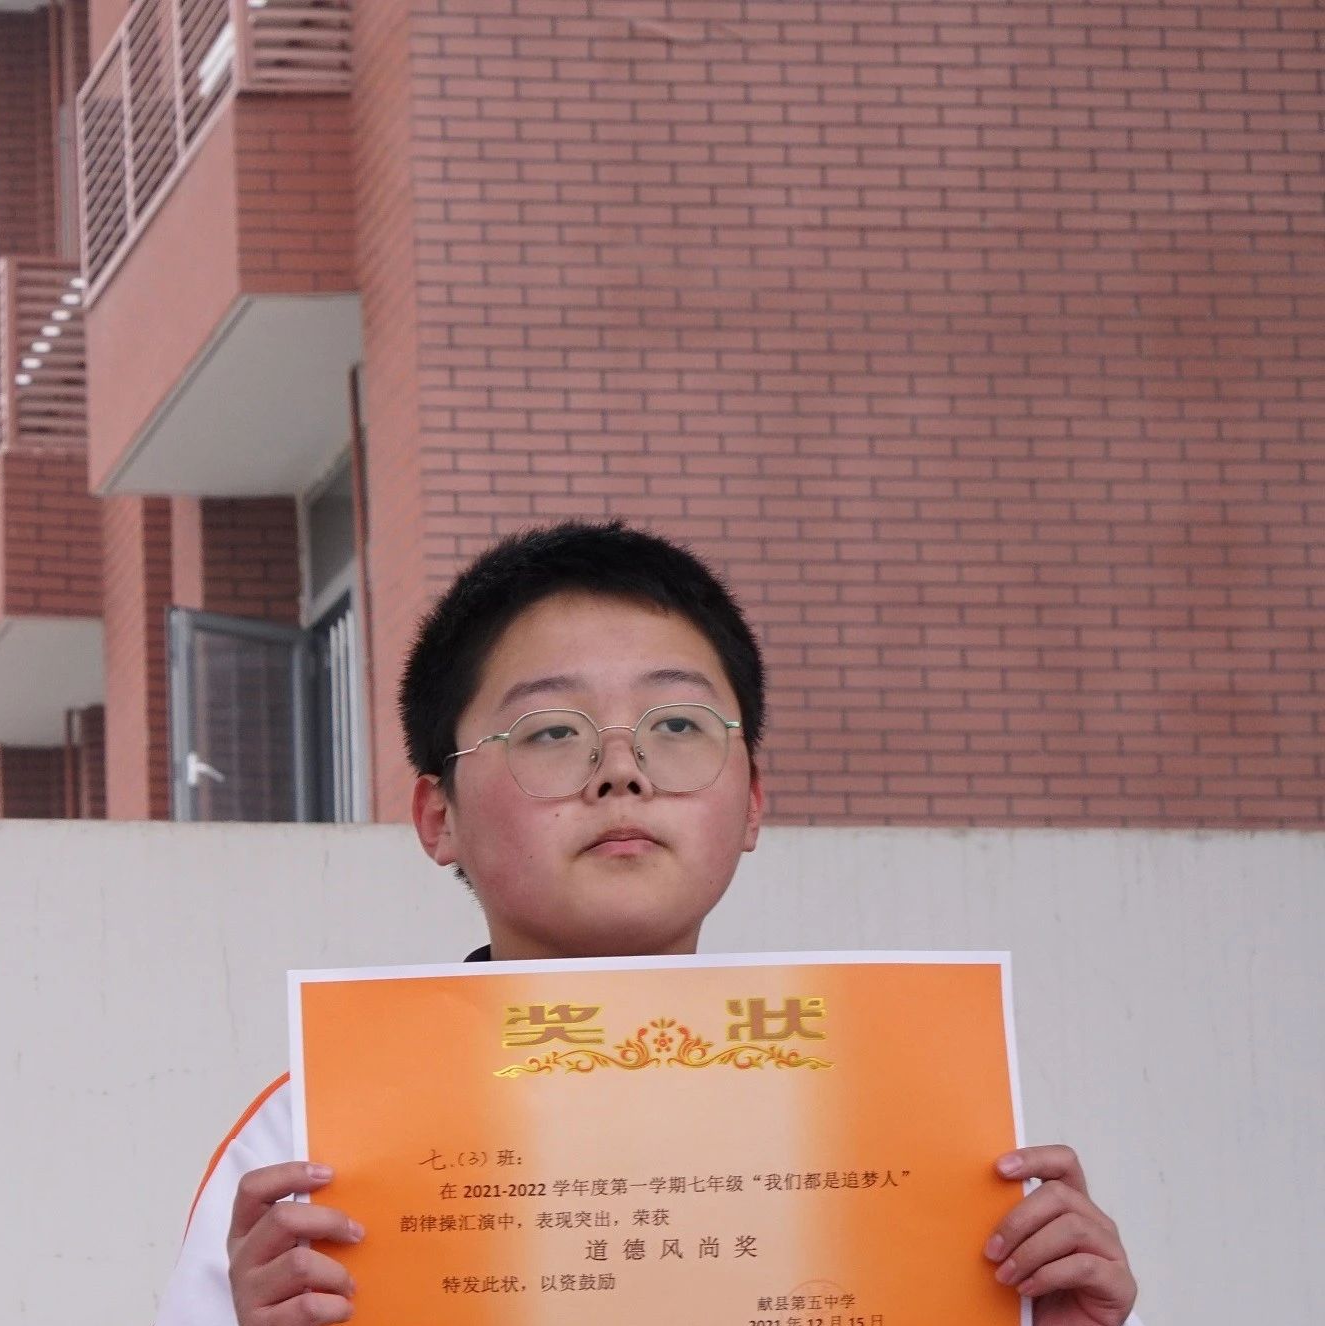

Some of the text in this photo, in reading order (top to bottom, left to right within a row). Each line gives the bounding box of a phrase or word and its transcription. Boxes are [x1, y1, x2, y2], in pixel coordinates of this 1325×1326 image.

[756, 1294, 857, 1312] 献县第五中学
